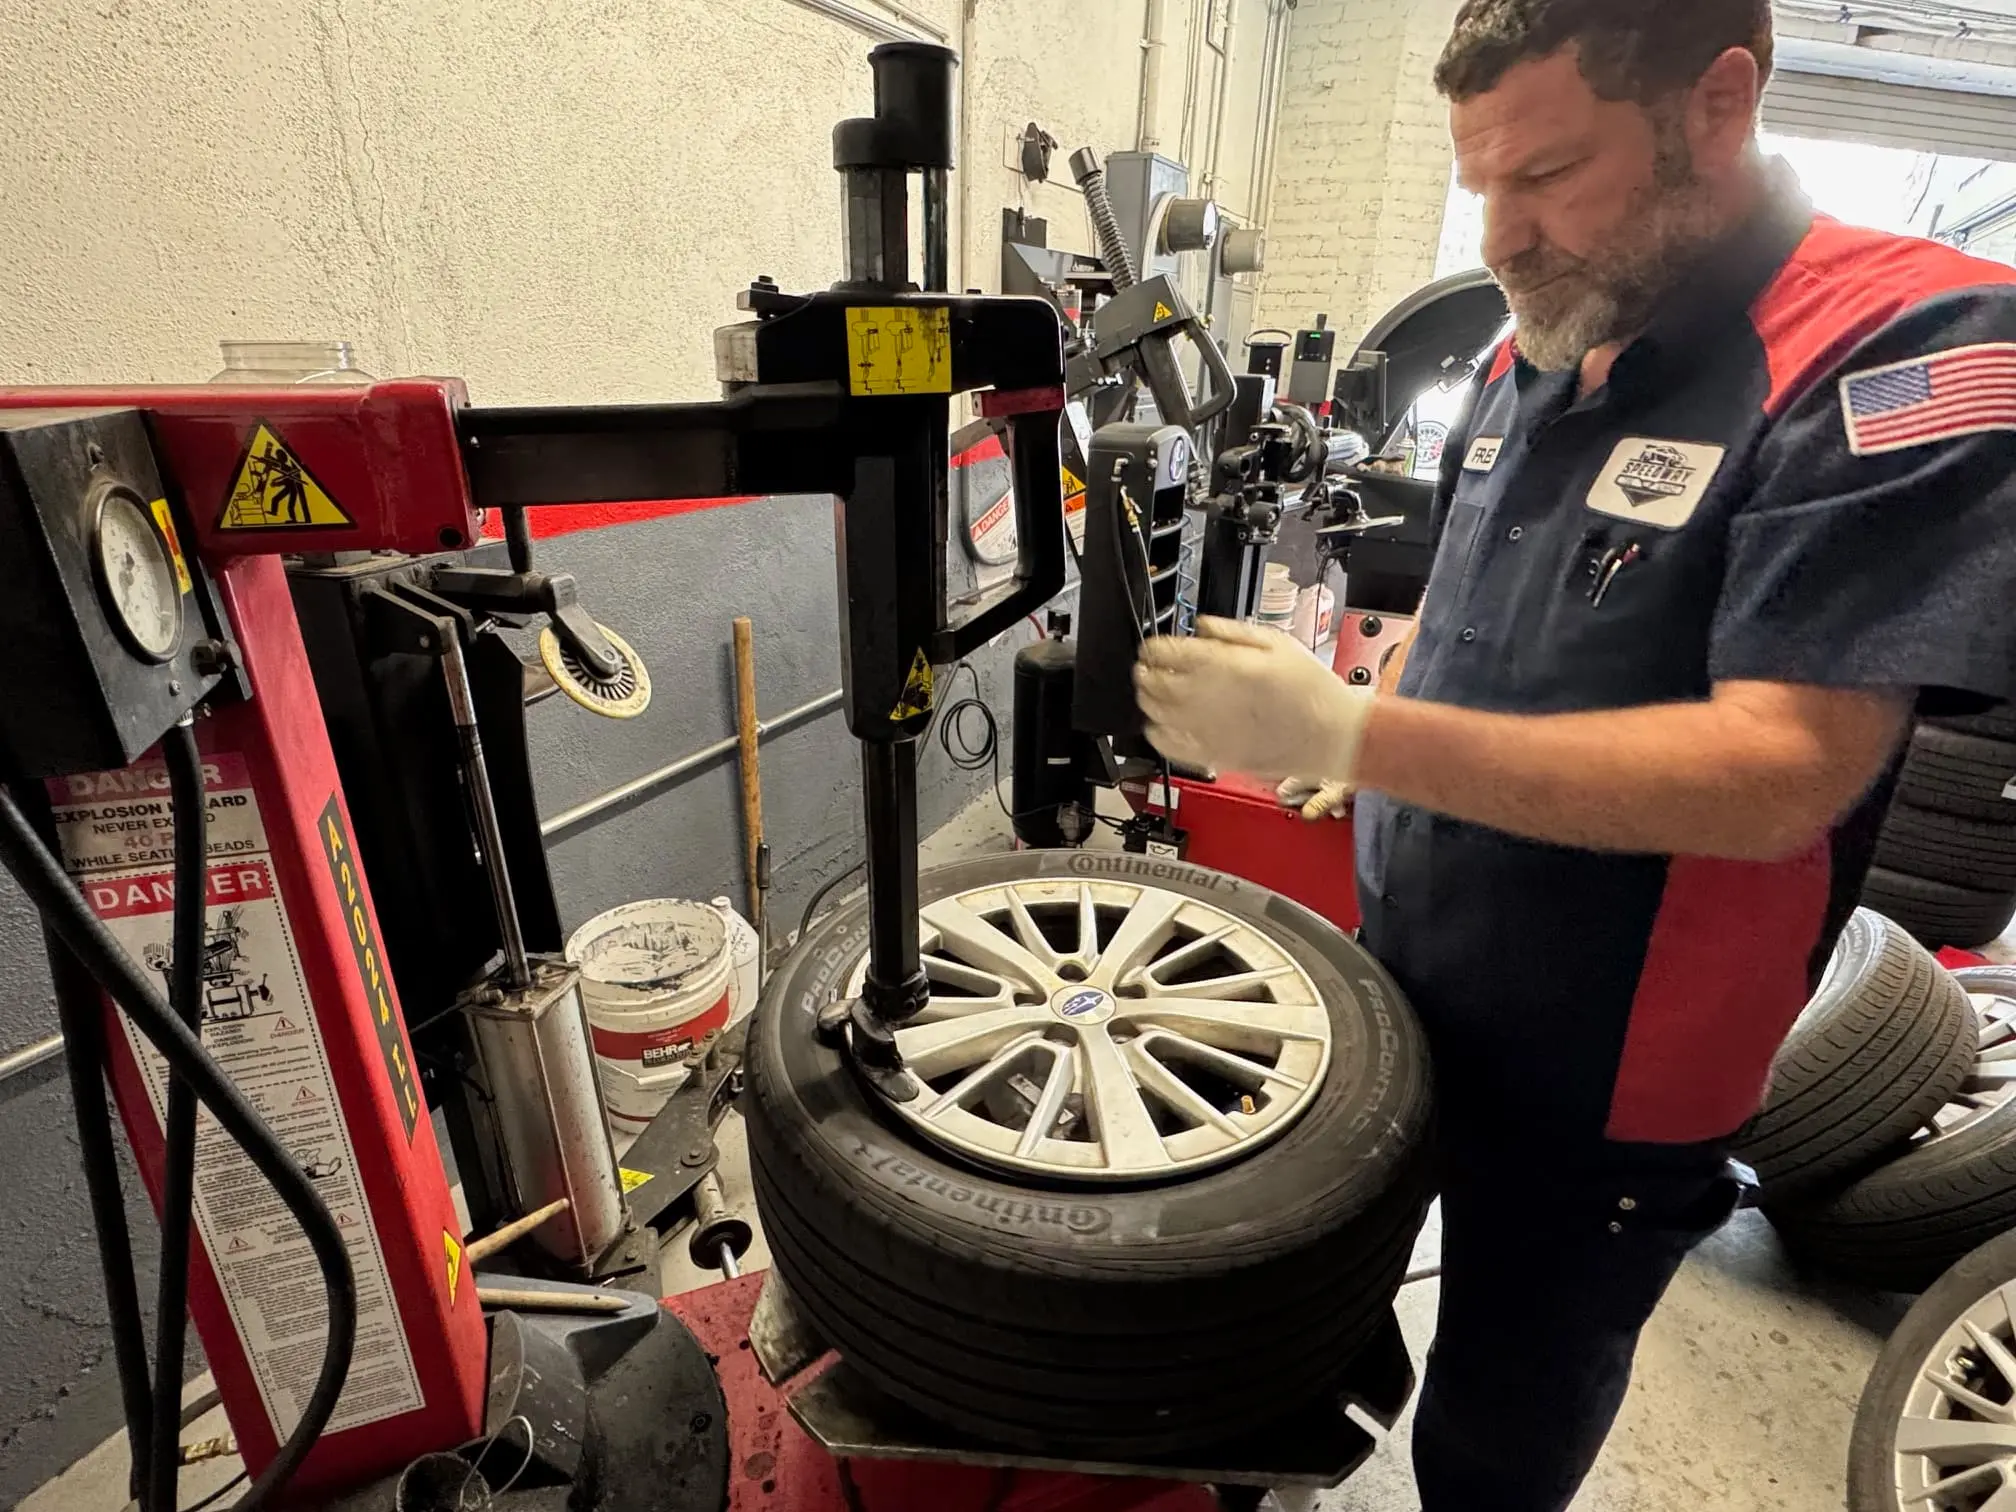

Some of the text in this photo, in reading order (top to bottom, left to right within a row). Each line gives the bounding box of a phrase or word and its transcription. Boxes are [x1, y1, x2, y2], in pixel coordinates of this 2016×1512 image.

[1622, 461, 1695, 482] SPEEDWAY
[68, 763, 223, 797] DANGR
[54, 802, 163, 824] EXPLOSION
[93, 817, 148, 834] NEVER
[72, 853, 123, 868] WHILE
[1067, 853, 1221, 890] Continental
[92, 869, 264, 910] DANER
[327, 815, 390, 1027] A2024
[643, 1044, 678, 1060] BEHR
[869, 1155, 1113, 1235] Continental
